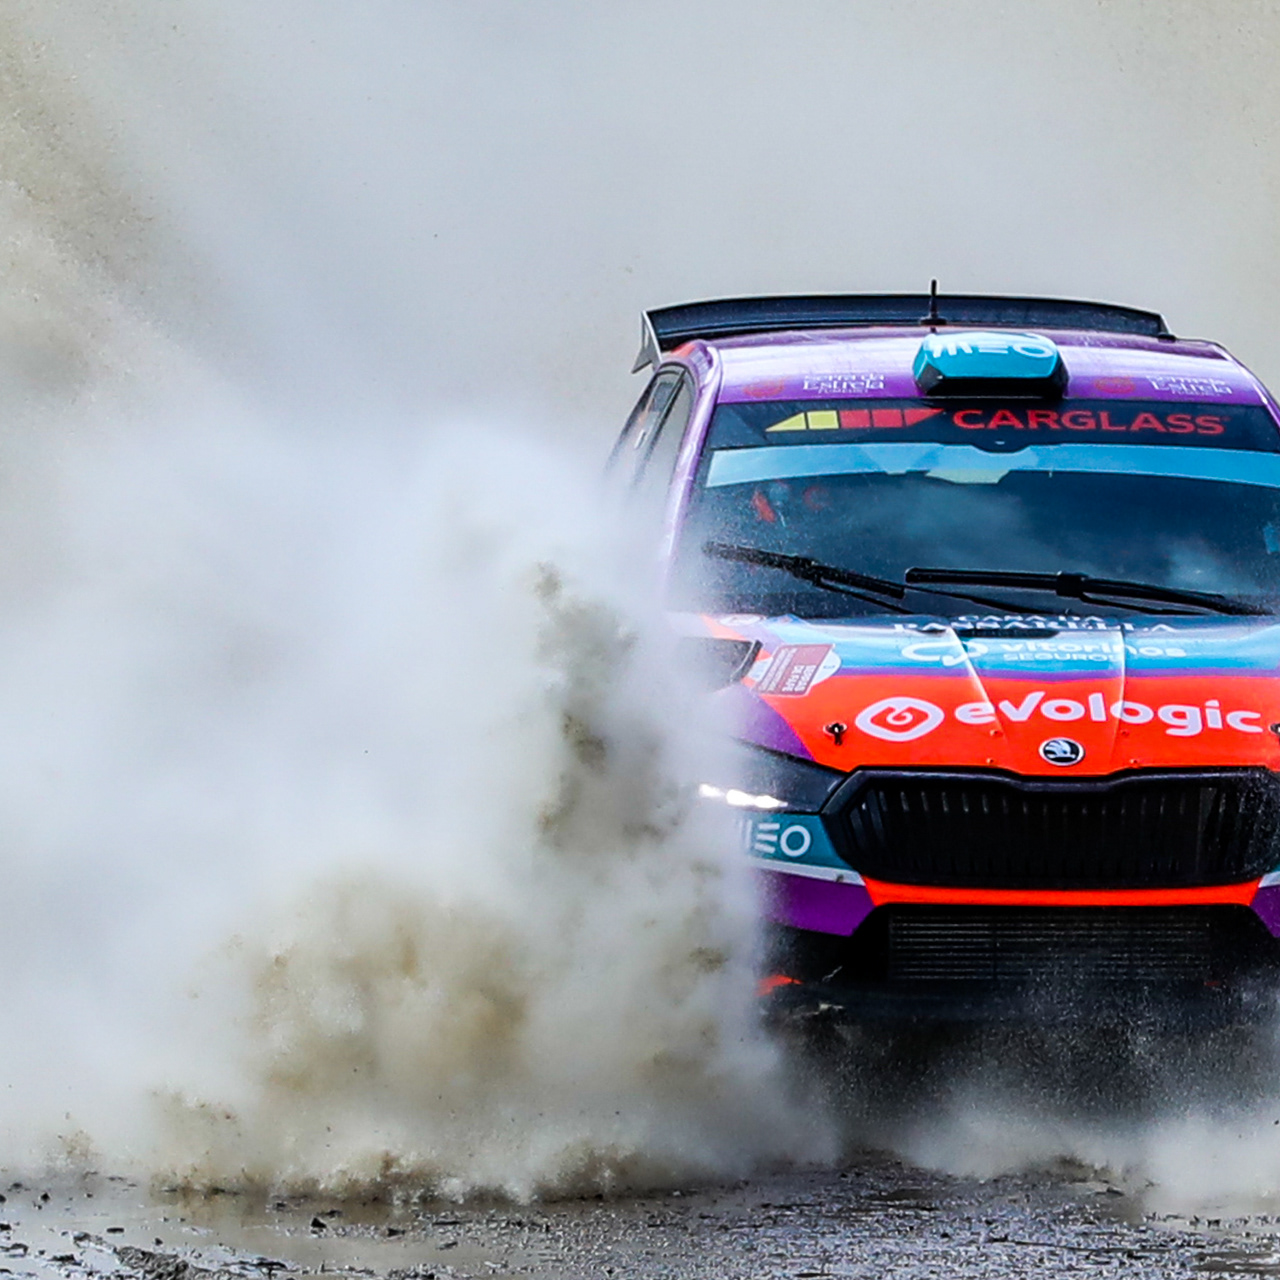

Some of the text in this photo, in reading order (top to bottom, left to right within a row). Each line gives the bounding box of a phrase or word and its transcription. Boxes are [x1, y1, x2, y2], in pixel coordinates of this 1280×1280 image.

[952, 409, 1225, 435] CARGLASS
[1000, 641, 1188, 658] vitorinos
[954, 690, 1264, 736] evologic
